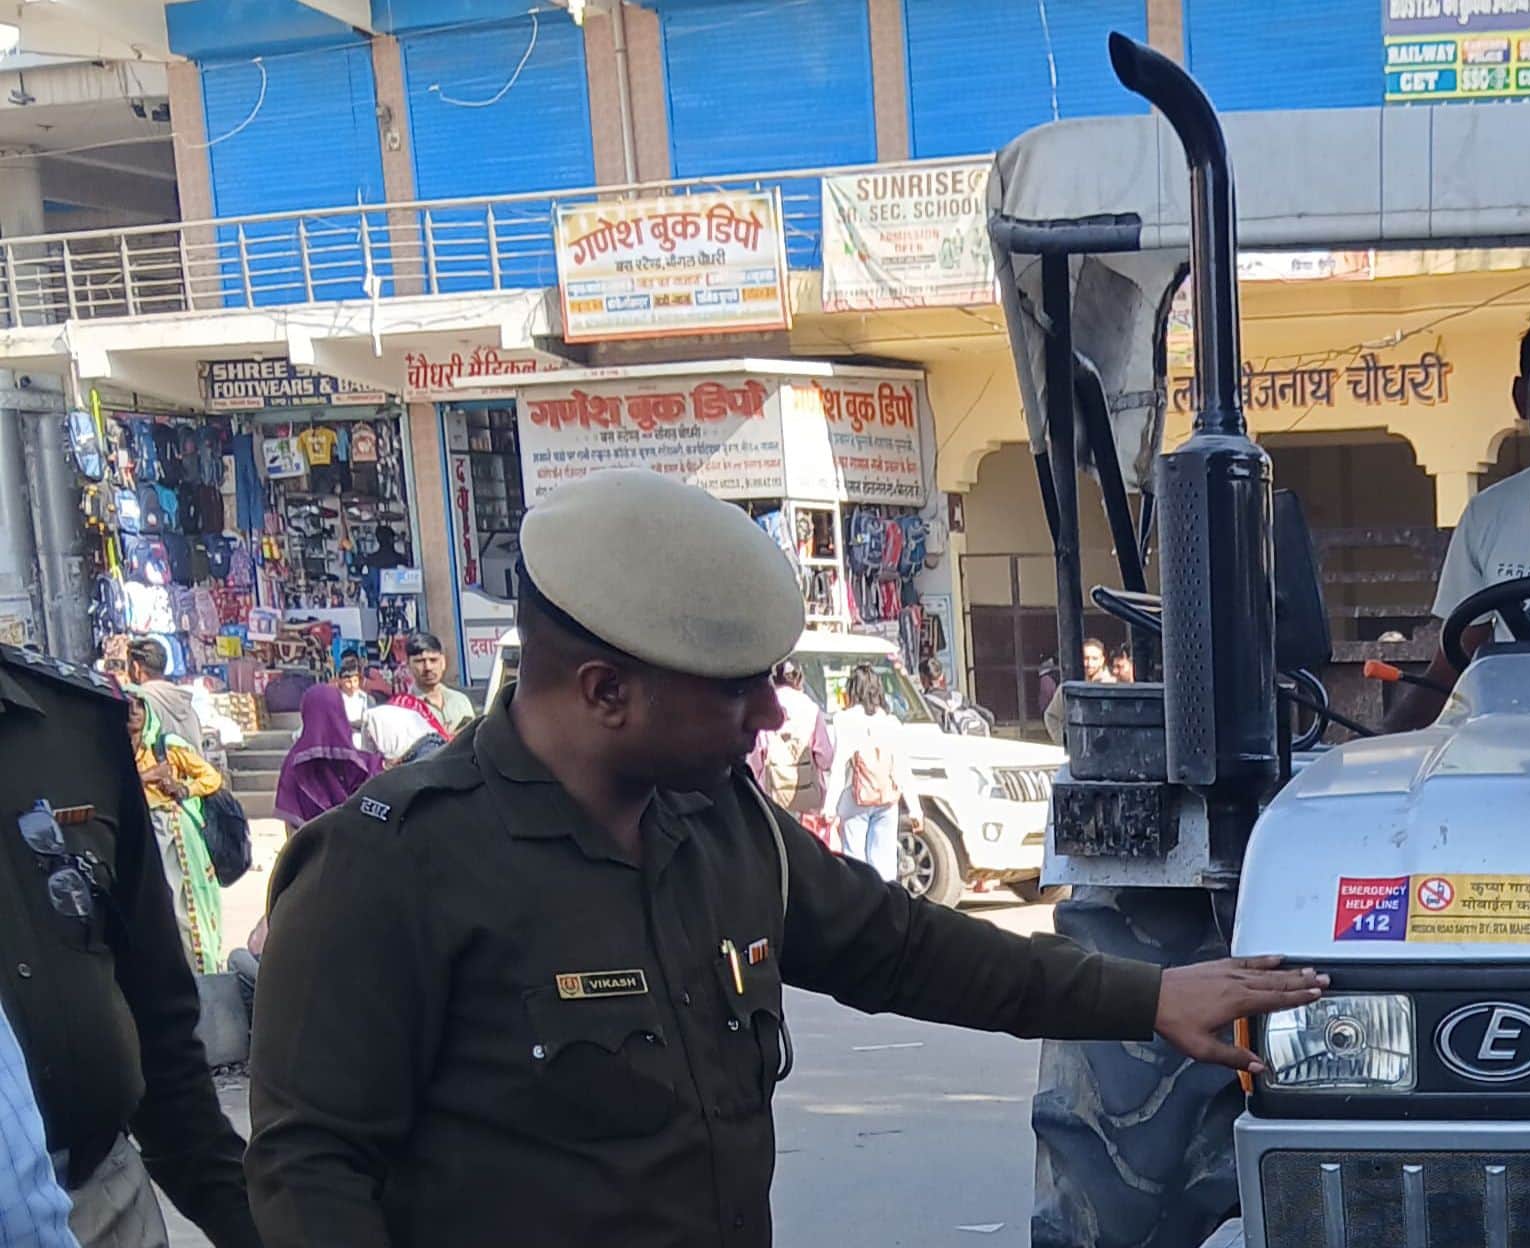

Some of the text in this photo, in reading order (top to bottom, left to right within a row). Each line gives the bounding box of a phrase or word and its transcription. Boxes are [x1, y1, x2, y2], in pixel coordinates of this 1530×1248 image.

[1387, 44, 1456, 64] RAILWAY
[857, 170, 965, 201] SUNRISE
[869, 203, 907, 222] SEC.
[913, 198, 982, 219] SCHOOL
[567, 202, 763, 267] गणेश बुक डिपो
[213, 360, 289, 381] SHREE
[1346, 352, 1452, 408] चौधरी
[213, 378, 314, 398] FOOTWEARS
[319, 377, 333, 394] &
[527, 379, 766, 432] गणेश बुक डिपो
[878, 381, 914, 430] डिपो
[1341, 885, 1407, 896] EMERGENCY
[1346, 899, 1400, 910] HELP LINE
[1353, 914, 1390, 932] 112
[589, 977, 637, 990] VIKASH
